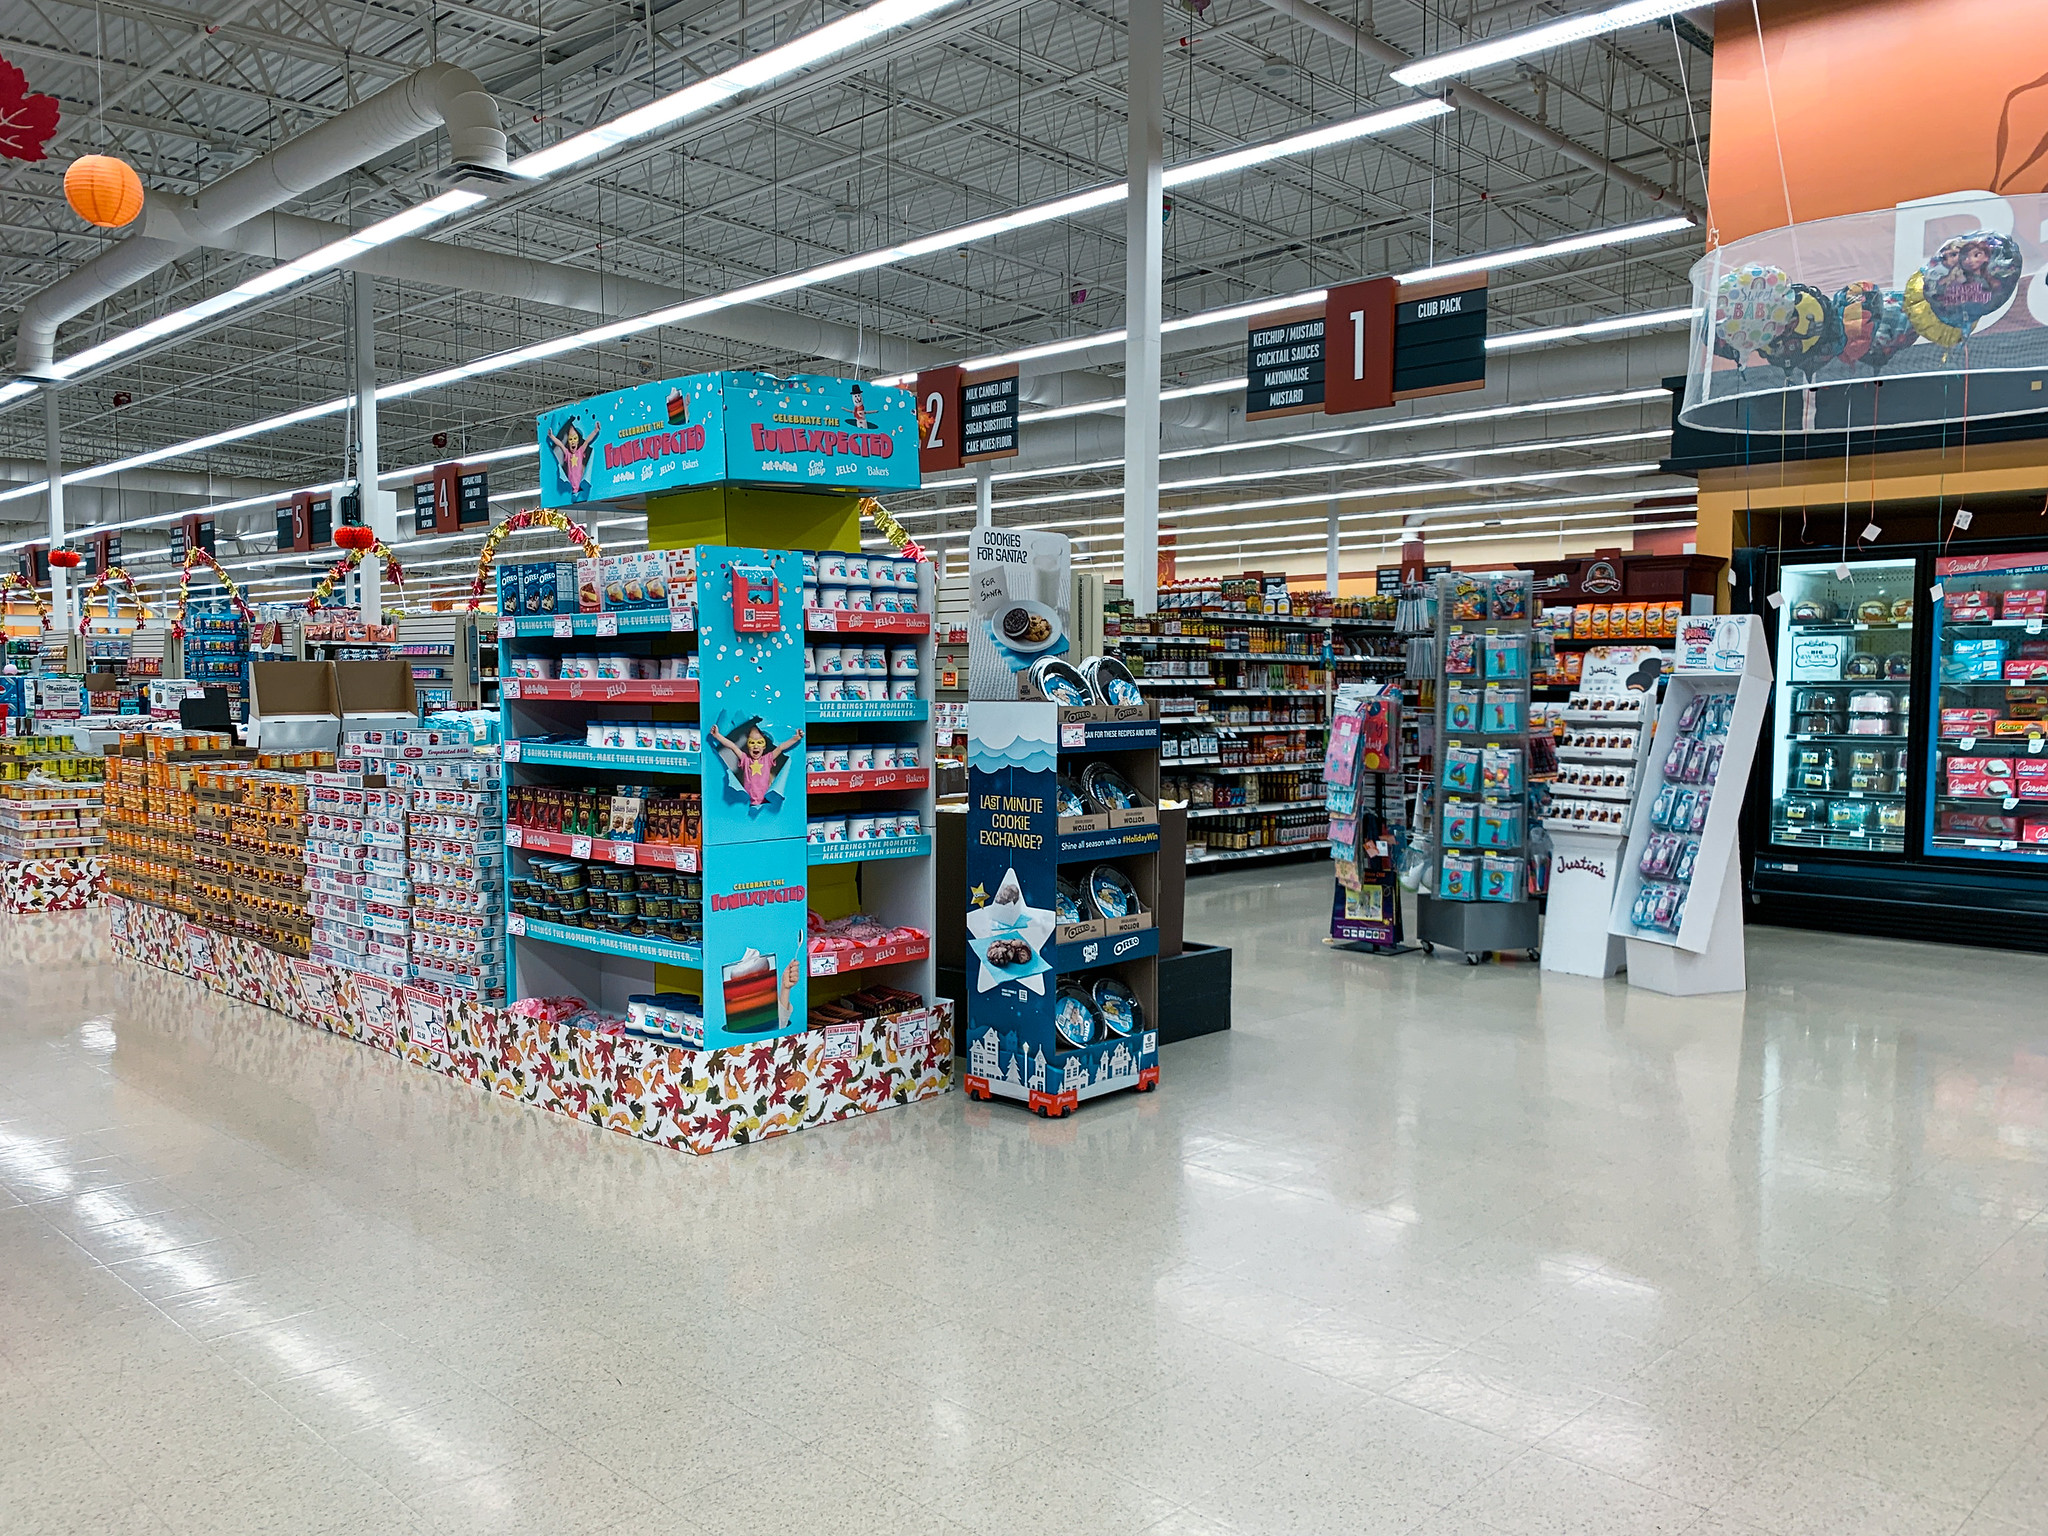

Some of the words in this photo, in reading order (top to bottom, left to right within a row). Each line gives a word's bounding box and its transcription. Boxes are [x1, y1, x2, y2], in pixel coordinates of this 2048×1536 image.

[1741, 287, 1773, 302] Sweet
[1417, 302, 1438, 319] CLUB
[1439, 296, 1462, 314] PACK
[1733, 302, 1778, 320] BABY
[1253, 330, 1284, 347] KETCHUP
[1290, 322, 1324, 341] MUSTARD
[1350, 309, 1364, 380] 1
[1256, 349, 1289, 367] COCKTAIL
[1291, 344, 1320, 362] SAUCES
[1264, 366, 1309, 386] MAYONNAISE
[966, 388, 978, 401] MILK
[978, 383, 998, 398] CANNED
[1002, 381, 1012, 394] DRY
[1269, 389, 1304, 406] MUSTARD
[971, 402, 990, 417] BAKING
[990, 400, 1007, 414] NEEDS
[772, 413, 822, 426] CELEBRATE
[824, 417, 840, 427] THE
[926, 392, 944, 449] 2
[965, 420, 983, 435] SUGAR
[983, 417, 1012, 433] SUBSTITUTE
[618, 423, 652, 438] CELEBRATE
[653, 421, 664, 431] THE
[604, 424, 705, 470] FUNEXPECTED
[751, 423, 893, 459] FUNEXPECTED
[966, 440, 979, 453] CAKE
[809, 459, 823, 469] Cool
[808, 467, 826, 477] Whip
[439, 478, 448, 517] 4
[296, 504, 302, 539] 5
[977, 547, 994, 562] FOR
[995, 548, 1027, 564] SANTA?
[1948, 559, 1980, 573] Carvel
[501, 574, 518, 586] OREO
[539, 572, 556, 584] OREO
[980, 577, 996, 589] FOR
[2006, 663, 2029, 672] Carvel
[820, 702, 834, 710] LIFE
[837, 702, 863, 710] BRINGS
[865, 702, 877, 710] THE
[1118, 707, 1138, 720] OREO
[820, 710, 840, 718] MAKE
[842, 710, 861, 718] THEM
[1068, 710, 1091, 723] OREO
[1094, 730, 1103, 738] FOR
[1104, 730, 1118, 738] THESE
[1118, 729, 1135, 737] RECIPES
[1135, 728, 1144, 736] AND
[1144, 728, 1157, 736] MORE
[527, 748, 549, 758] BRINGS
[550, 749, 562, 758] THE
[563, 750, 595, 761] MOMENTS.
[596, 753, 615, 762] MAKE
[616, 754, 635, 763] THEM
[636, 755, 654, 764] EVEN
[655, 756, 690, 767] SWEETER.
[1949, 759, 1978, 770] Carvel
[2016, 760, 2047, 772] Carvel
[1950, 779, 1979, 790] Carvel
[980, 795, 1001, 810] LAST
[1124, 816, 1145, 824] BOTTOM
[1072, 824, 1095, 832] BOTTOM
[823, 844, 838, 852] LIFE
[840, 842, 866, 851] BRINGS
[868, 841, 881, 849] THE
[883, 839, 919, 848] MOMENTS.
[980, 830, 1043, 850] EXCHANGE?
[1061, 841, 1077, 851] Shine
[1085, 839, 1105, 848] season
[1105, 837, 1117, 846] with
[1122, 832, 1158, 844] #HolidayWin
[823, 852, 843, 860] MAKE
[845, 850, 865, 858] THEM
[867, 848, 884, 856] EVEN
[885, 846, 919, 855] SWEETER.
[1557, 856, 1606, 878] Justin's
[733, 880, 771, 890] CELEBRATE
[711, 885, 805, 912] FUNEXPECTED
[553, 930, 565, 939] THE
[1068, 924, 1090, 939] OREO
[1114, 937, 1140, 956] OREO
[357, 976, 371, 987] EXTRA
[406, 989, 422, 1001] EXTRA
